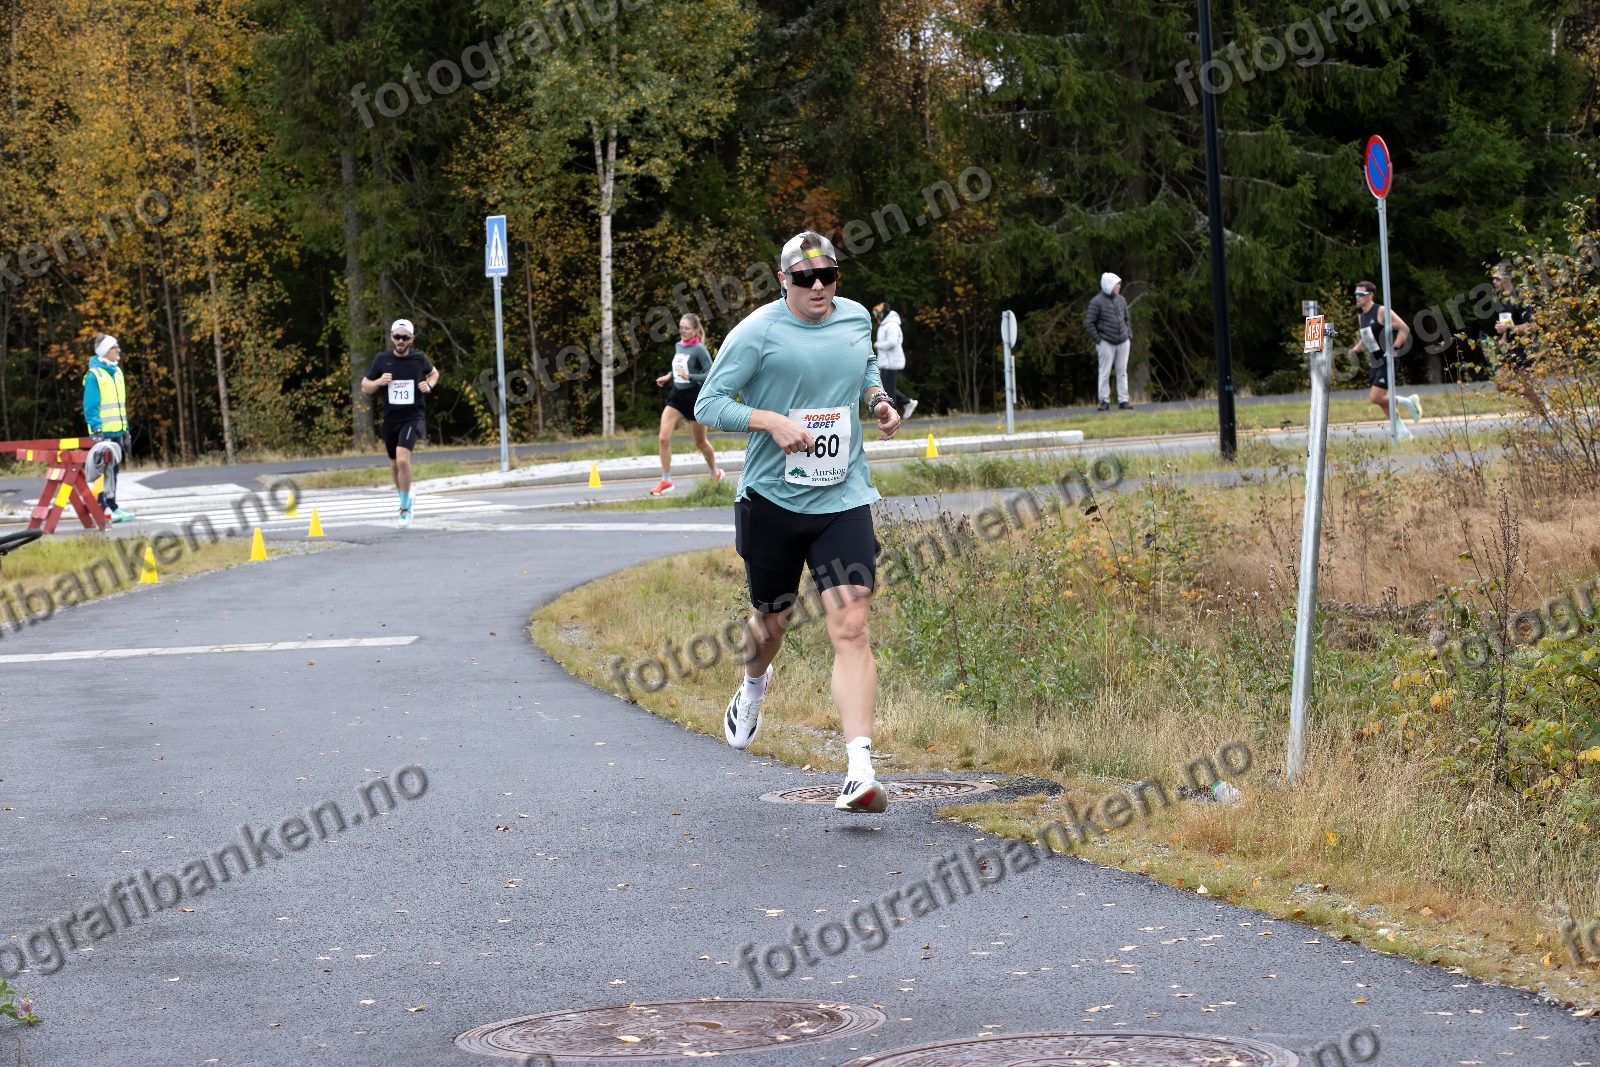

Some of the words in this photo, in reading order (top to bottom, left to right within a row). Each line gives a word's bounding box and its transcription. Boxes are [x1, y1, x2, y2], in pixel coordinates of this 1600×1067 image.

[393, 390, 409, 400] 713
[803, 413, 841, 422] NORGES
[806, 421, 836, 429] LØPET
[805, 434, 840, 458] 60
[812, 467, 846, 477] Aurskog
